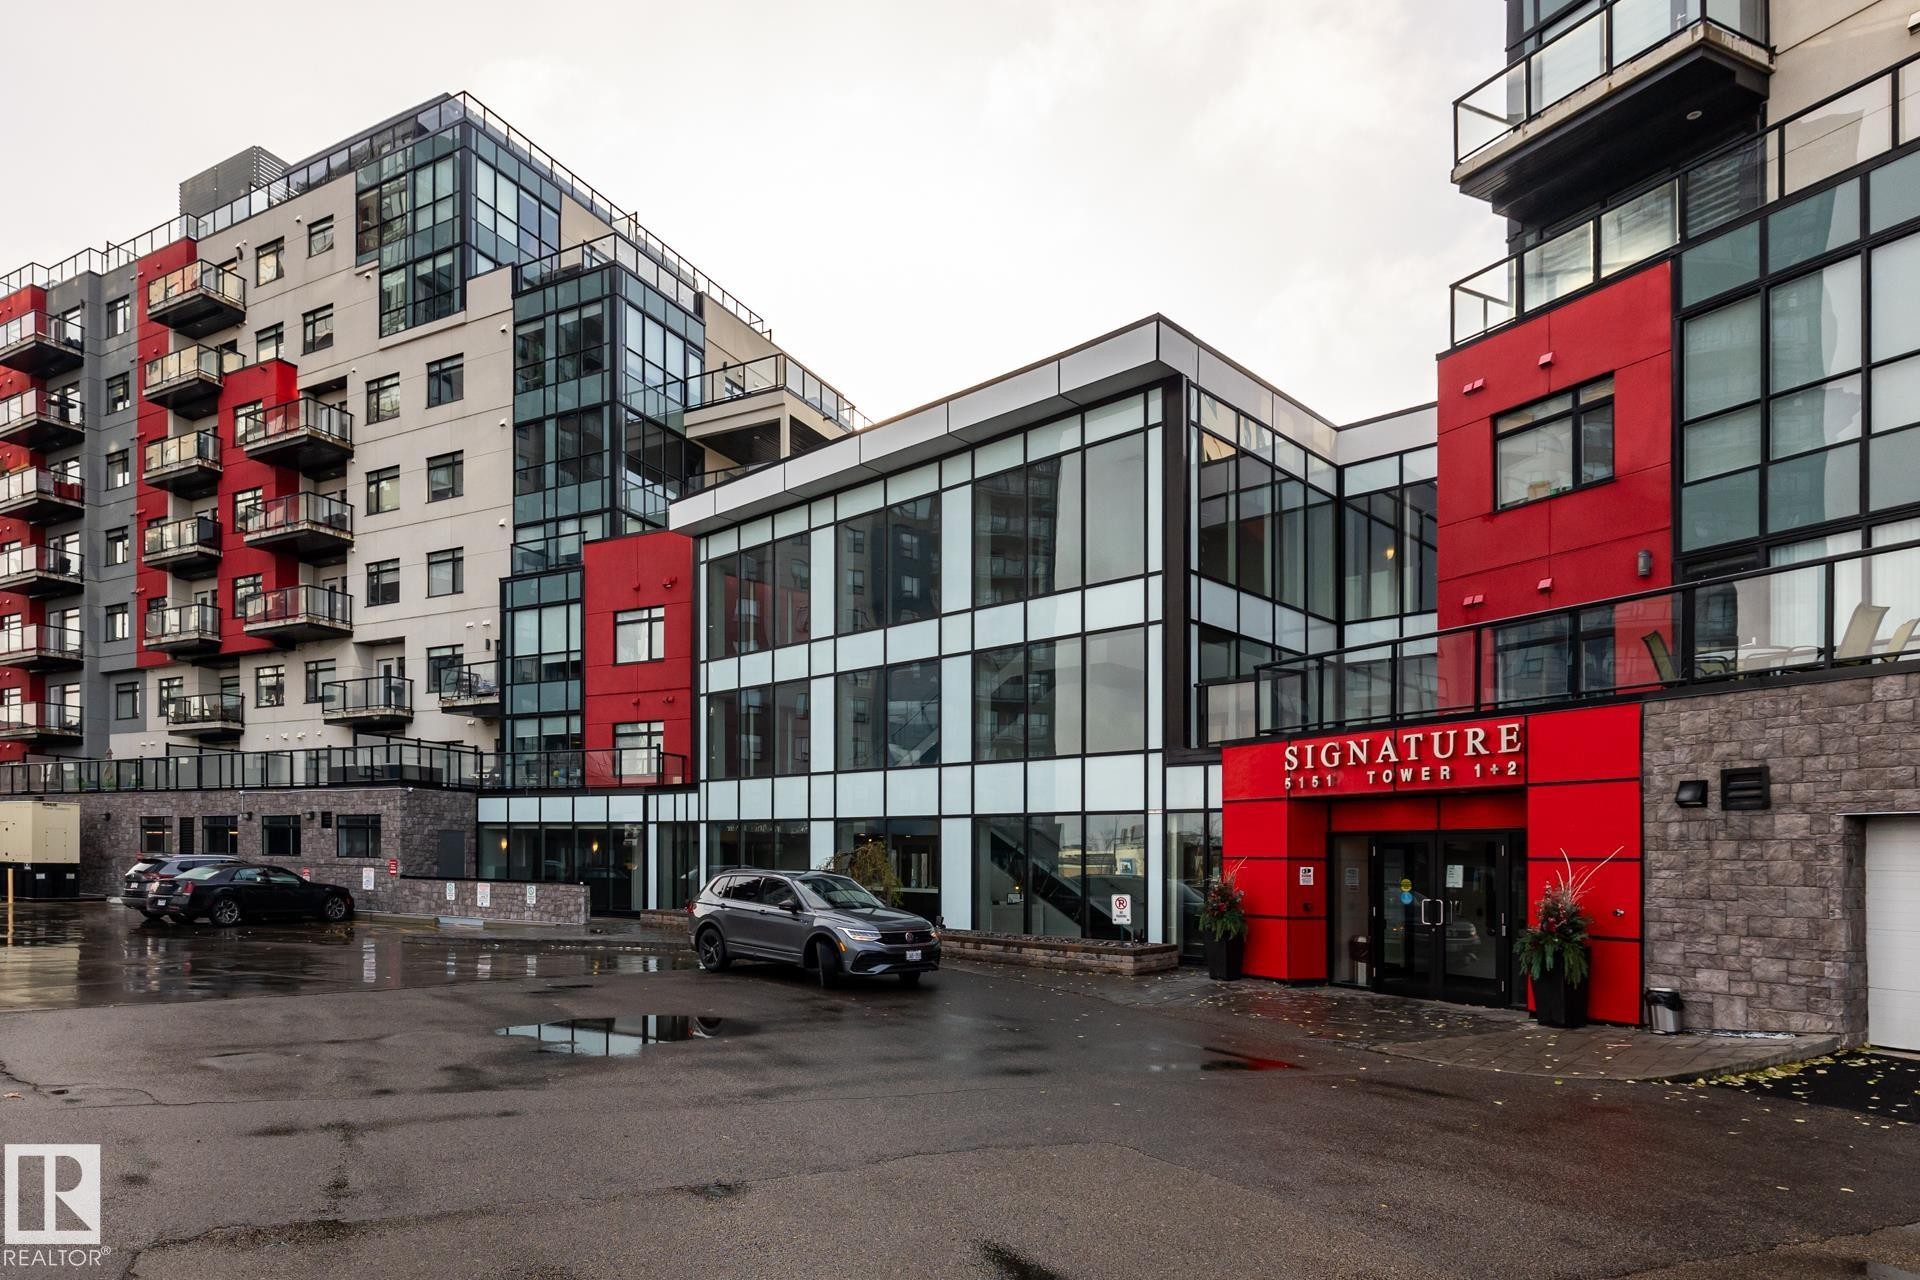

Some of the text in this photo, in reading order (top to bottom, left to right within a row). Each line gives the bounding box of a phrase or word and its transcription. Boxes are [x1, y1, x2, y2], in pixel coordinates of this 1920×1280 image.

[1284, 723, 1522, 771] SIGNATURE
[1284, 760, 1518, 790] 5151 TOWER 1+2
